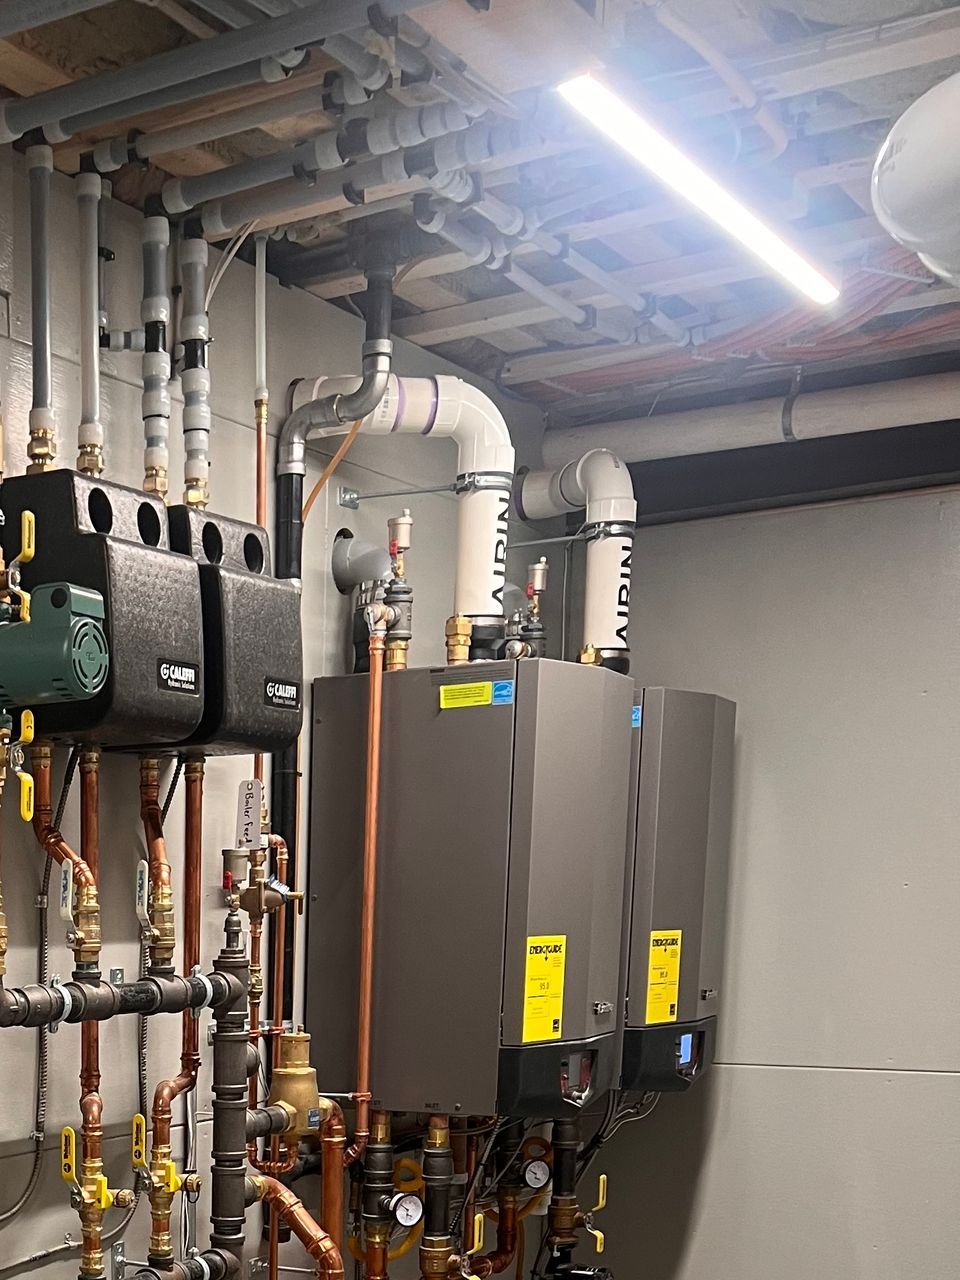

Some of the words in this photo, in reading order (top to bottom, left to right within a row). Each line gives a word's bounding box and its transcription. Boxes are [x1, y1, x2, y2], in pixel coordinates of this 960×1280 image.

[170, 665, 195, 682] CALEFFI
[275, 684, 297, 699] CALEFFI
[244, 792, 254, 818] Boiler
